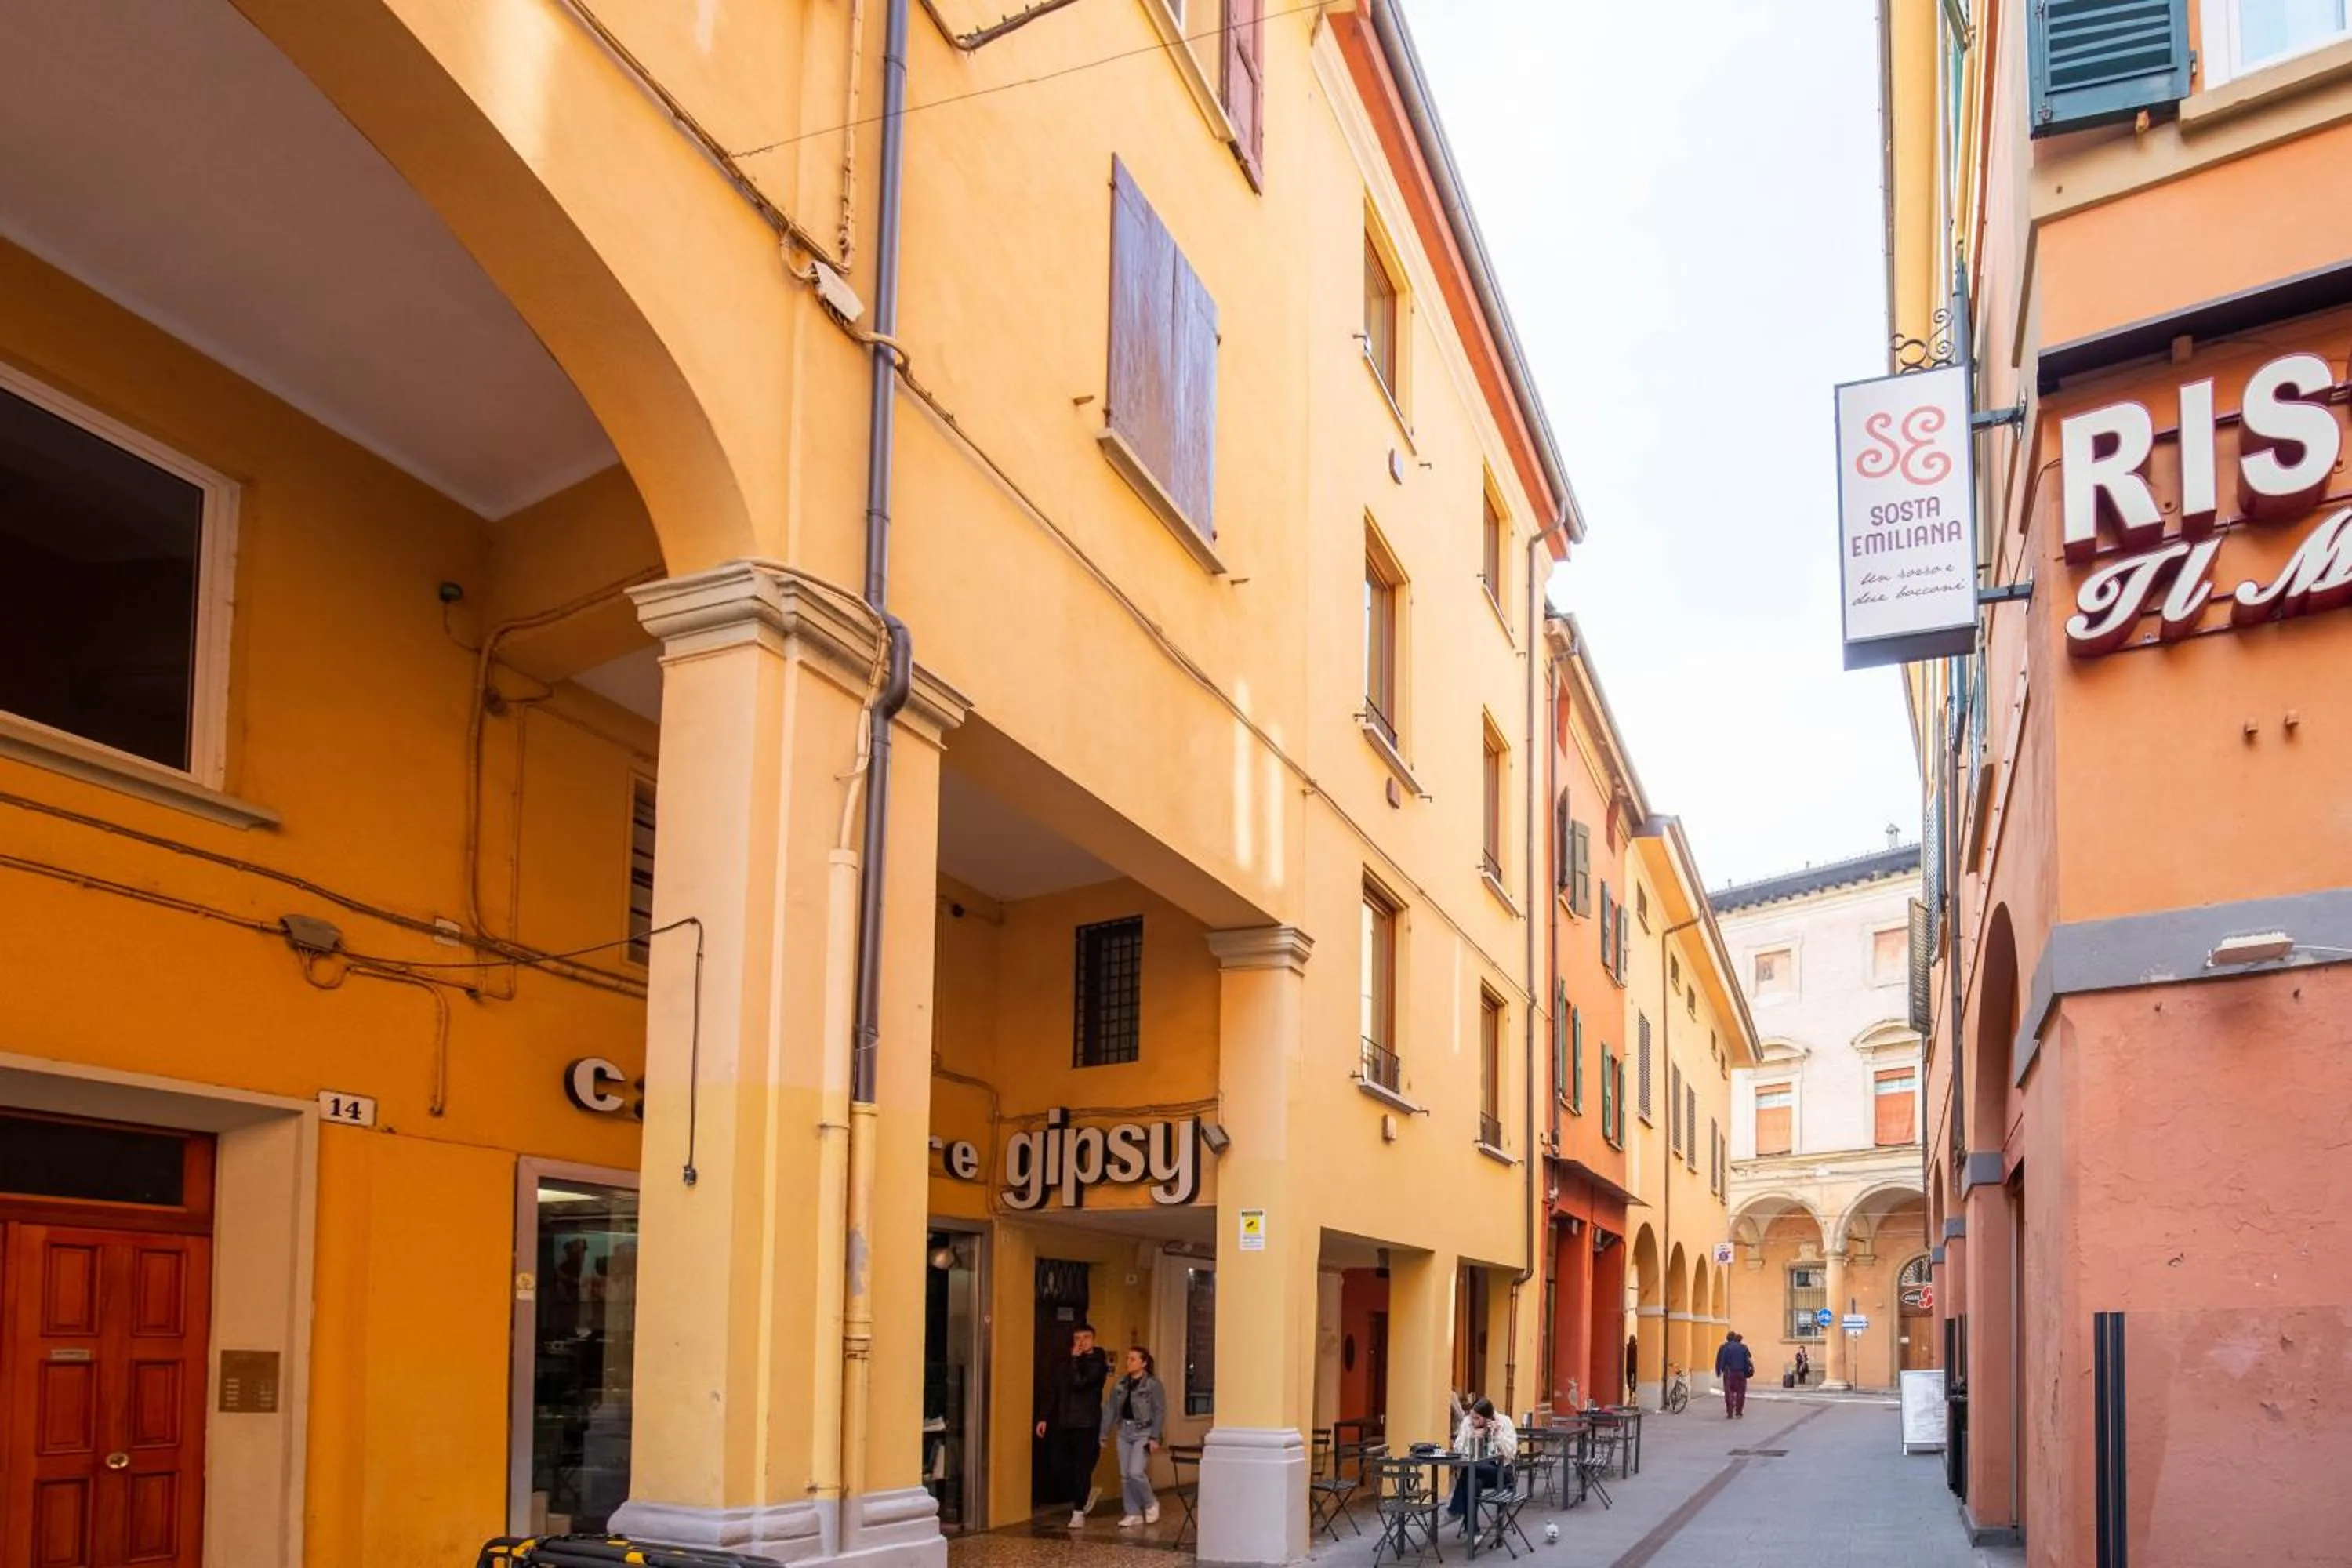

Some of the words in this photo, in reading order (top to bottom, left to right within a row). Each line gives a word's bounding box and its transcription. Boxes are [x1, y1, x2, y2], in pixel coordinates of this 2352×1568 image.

[1856, 405, 1952, 486] SE
[2060, 352, 2341, 545] RIS
[1870, 496, 1940, 527] SOSTA
[1851, 520, 1962, 557] EMILIANA
[1851, 591, 1889, 607] due
[330, 1097, 362, 1120] 14
[1001, 1108, 1194, 1210] gipsy
